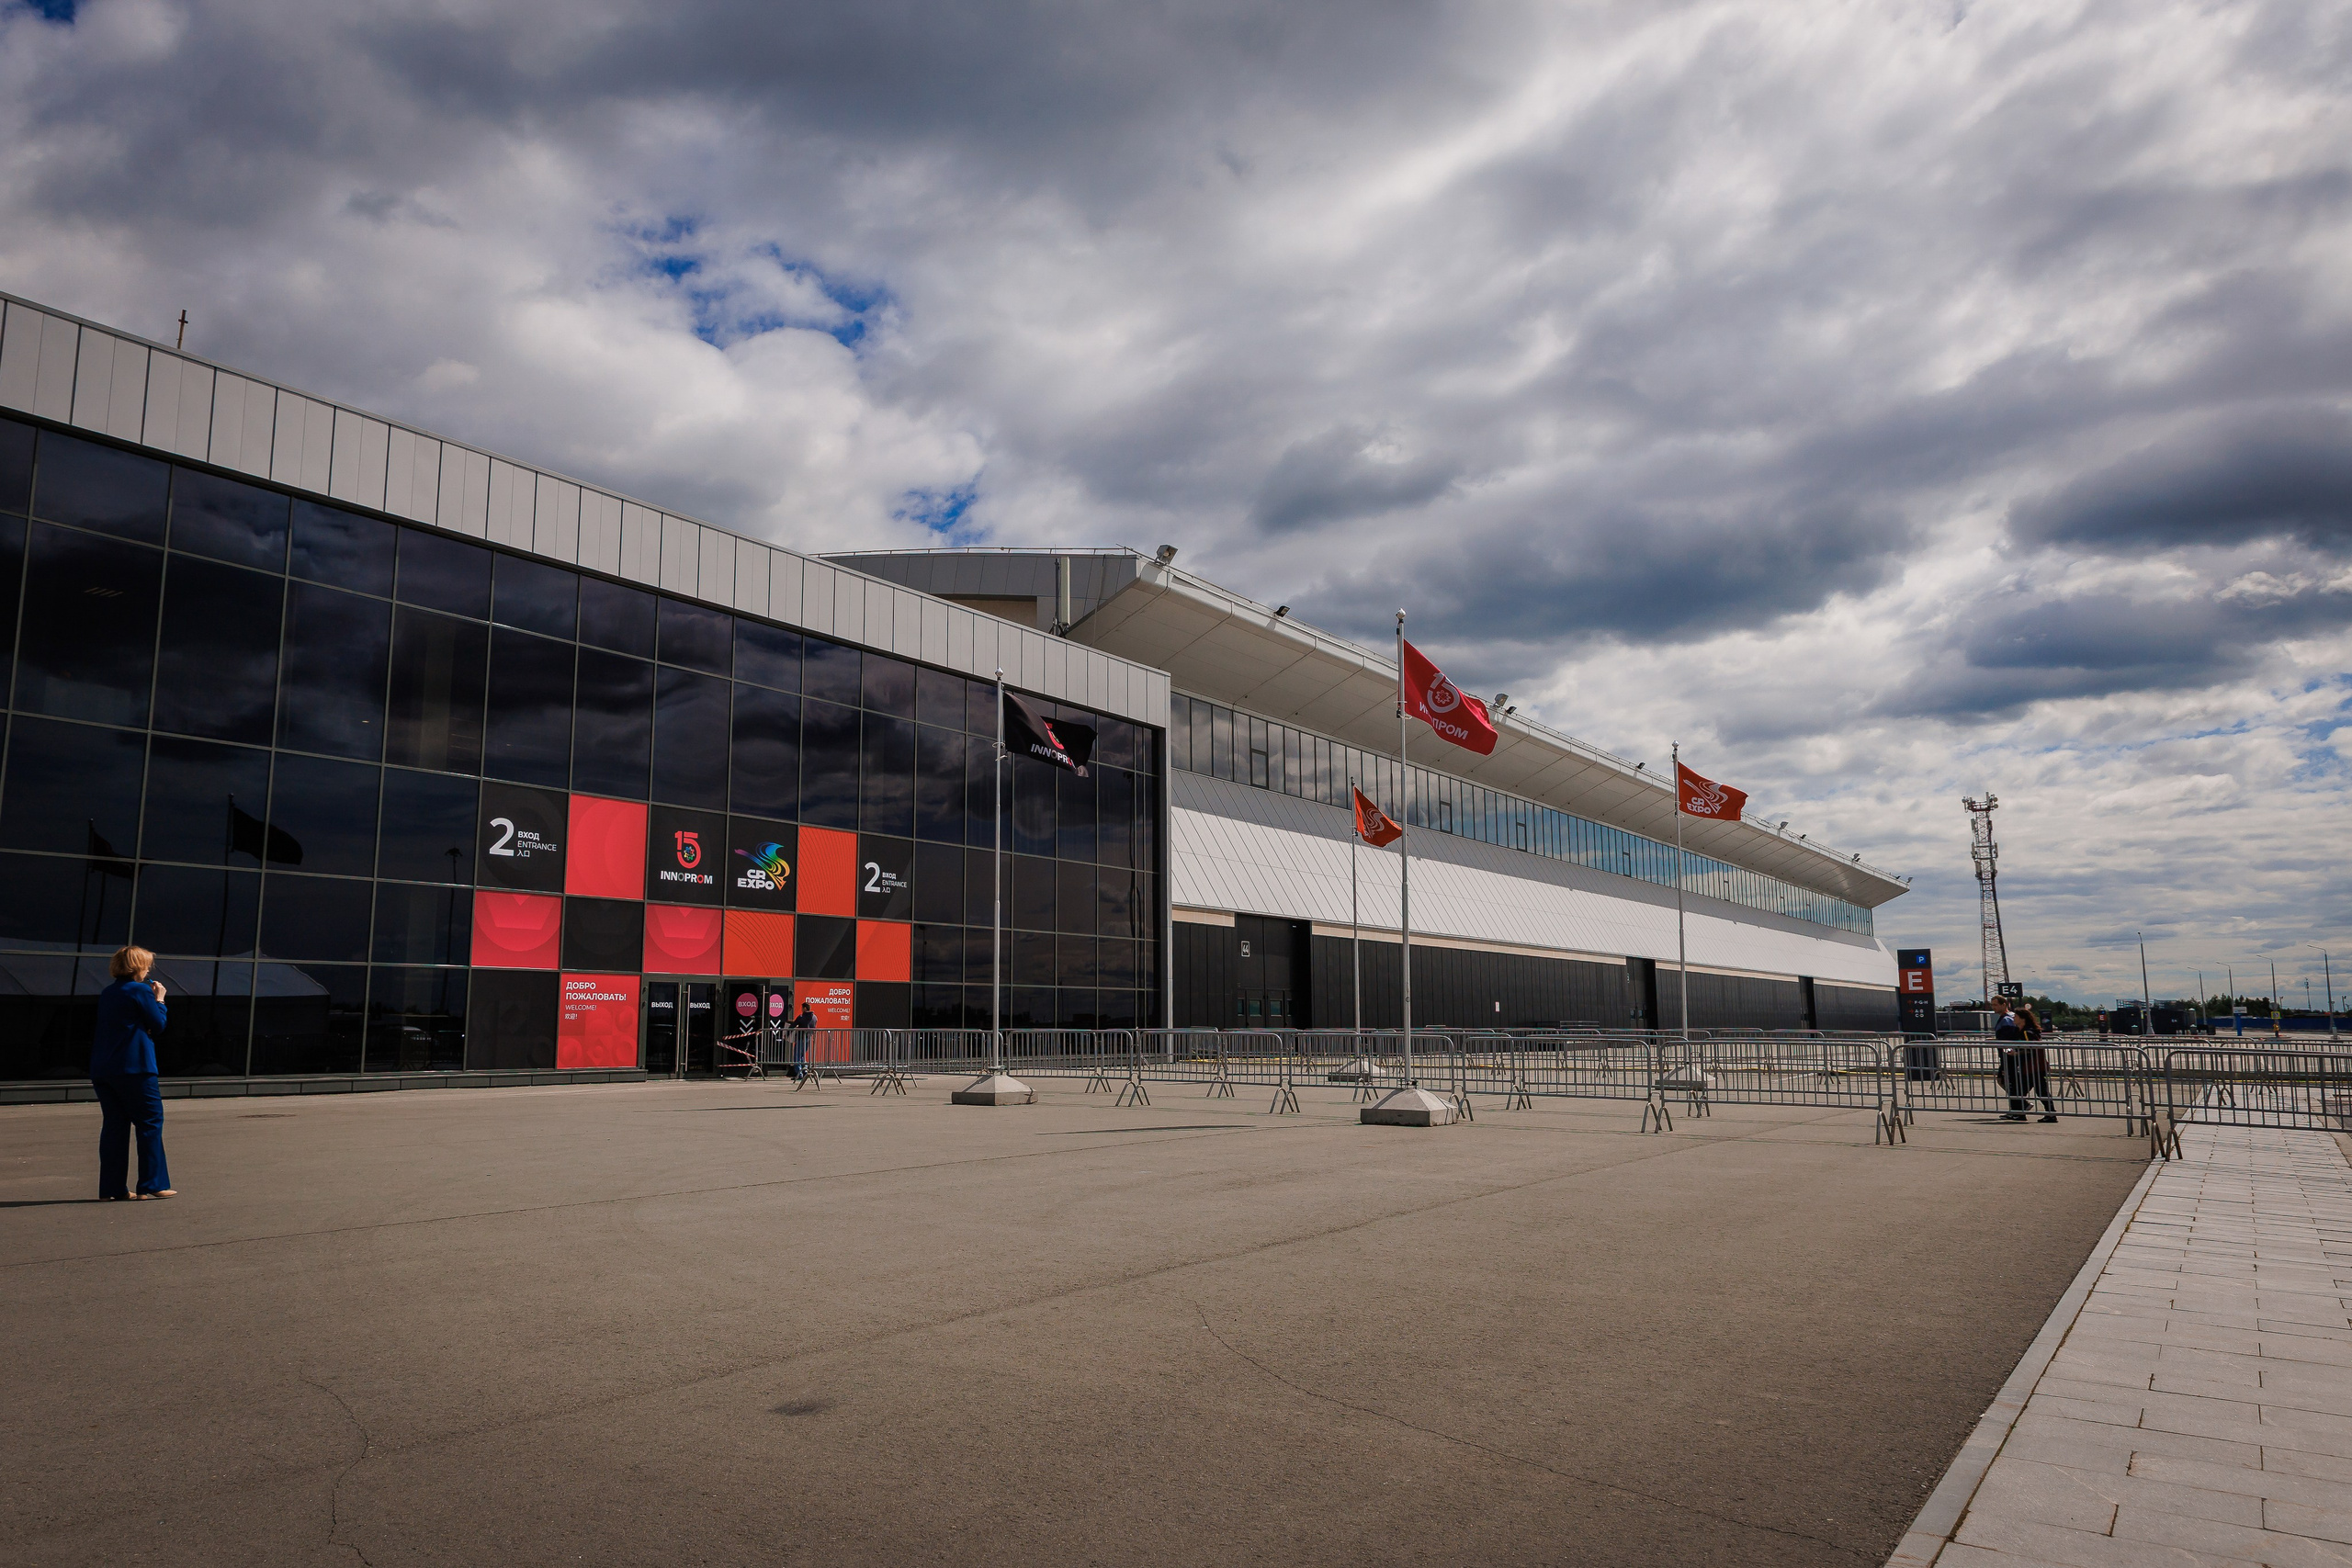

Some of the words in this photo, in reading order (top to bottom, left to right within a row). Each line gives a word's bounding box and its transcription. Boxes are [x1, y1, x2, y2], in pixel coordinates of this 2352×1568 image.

[1690, 796, 1705, 807] CR
[1686, 802, 1712, 815] EXPO
[489, 817, 514, 857] 2
[517, 830, 540, 841] ВХОД
[517, 840, 558, 852] ENTRANCE
[674, 830, 702, 869] 15
[516, 849, 530, 858] 入口
[660, 870, 713, 885] INNOPROM
[746, 868, 766, 880] CR
[864, 862, 881, 893] 2
[882, 872, 897, 880] ВХОД
[737, 877, 775, 891] EXPO
[881, 879, 908, 888] ENTRANCE
[565, 981, 596, 991] ДОБРО
[1906, 971, 1924, 991] E
[2002, 986, 2018, 995] E4
[565, 992, 627, 1001] ПОЖАЛОВАТЬ!
[805, 997, 851, 1005] ПОЖАЛОВАТЬ!
[650, 1001, 673, 1010] ВЫХОД
